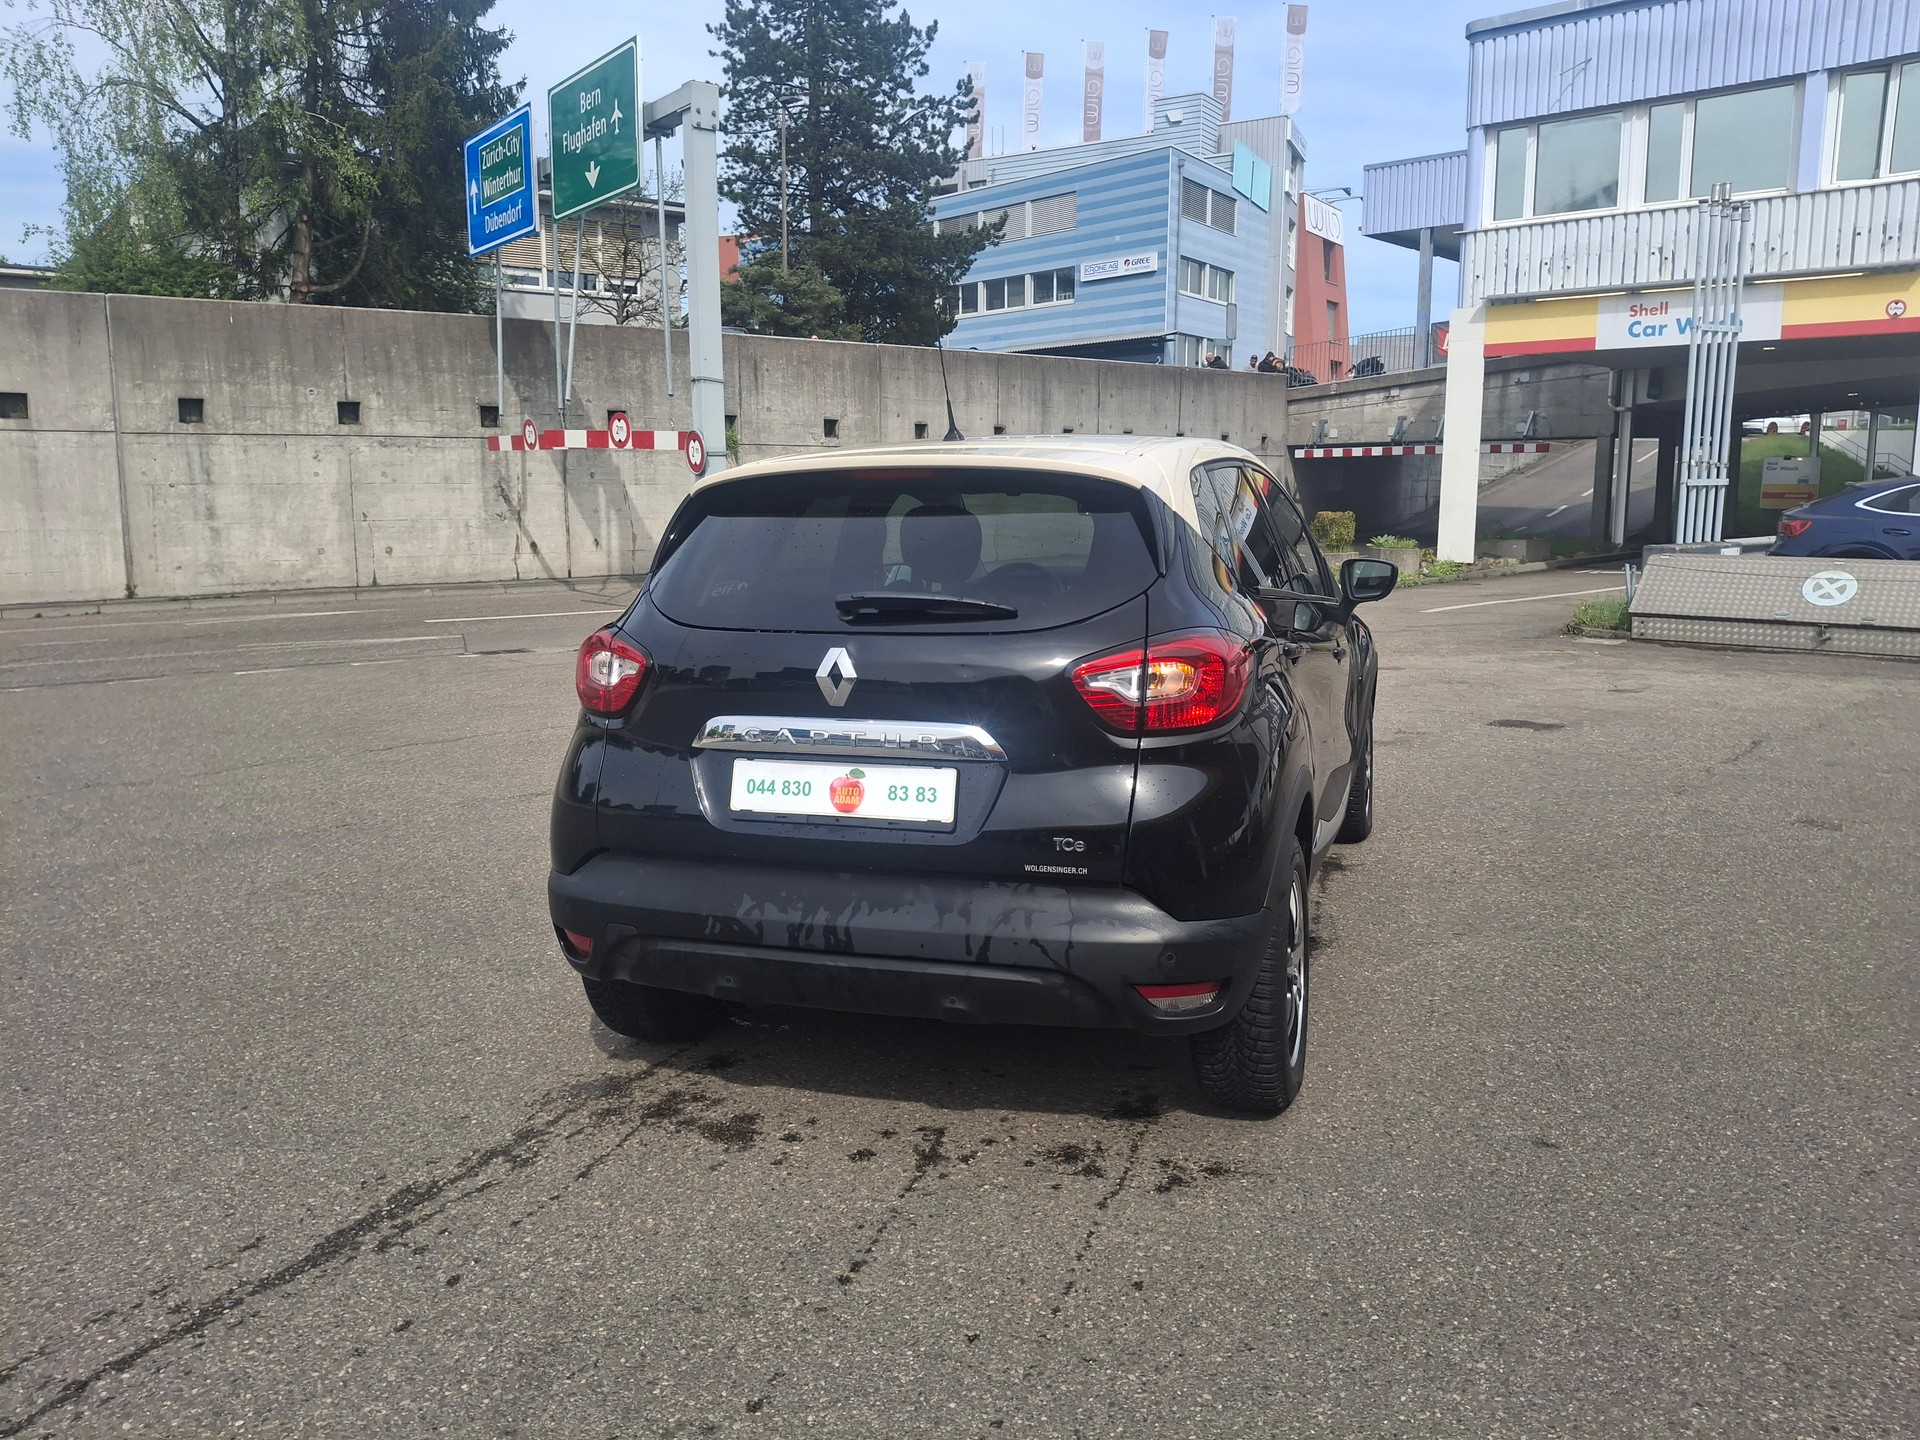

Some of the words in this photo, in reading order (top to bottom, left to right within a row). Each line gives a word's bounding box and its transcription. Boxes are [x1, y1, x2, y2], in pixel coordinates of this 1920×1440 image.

[580, 88, 601, 114] Bern
[562, 115, 607, 154] Flughafen
[481, 135, 521, 170] Zürich-City
[482, 167, 522, 199] Winterthur
[484, 199, 523, 234] Dübendorf
[1131, 257, 1151, 266] GREE
[1629, 301, 1669, 317] Shell
[1628, 320, 1668, 338] Car
[741, 726, 941, 751] CAPTUR
[746, 777, 776, 796] 044
[780, 780, 812, 797] 830
[887, 784, 909, 802] 83
[915, 786, 937, 803] 83
[833, 795, 860, 806] ADAM
[835, 786, 860, 797] AUTO
[1052, 837, 1086, 853] TCe
[1024, 864, 1088, 875] WOLGENSINGER.CH
